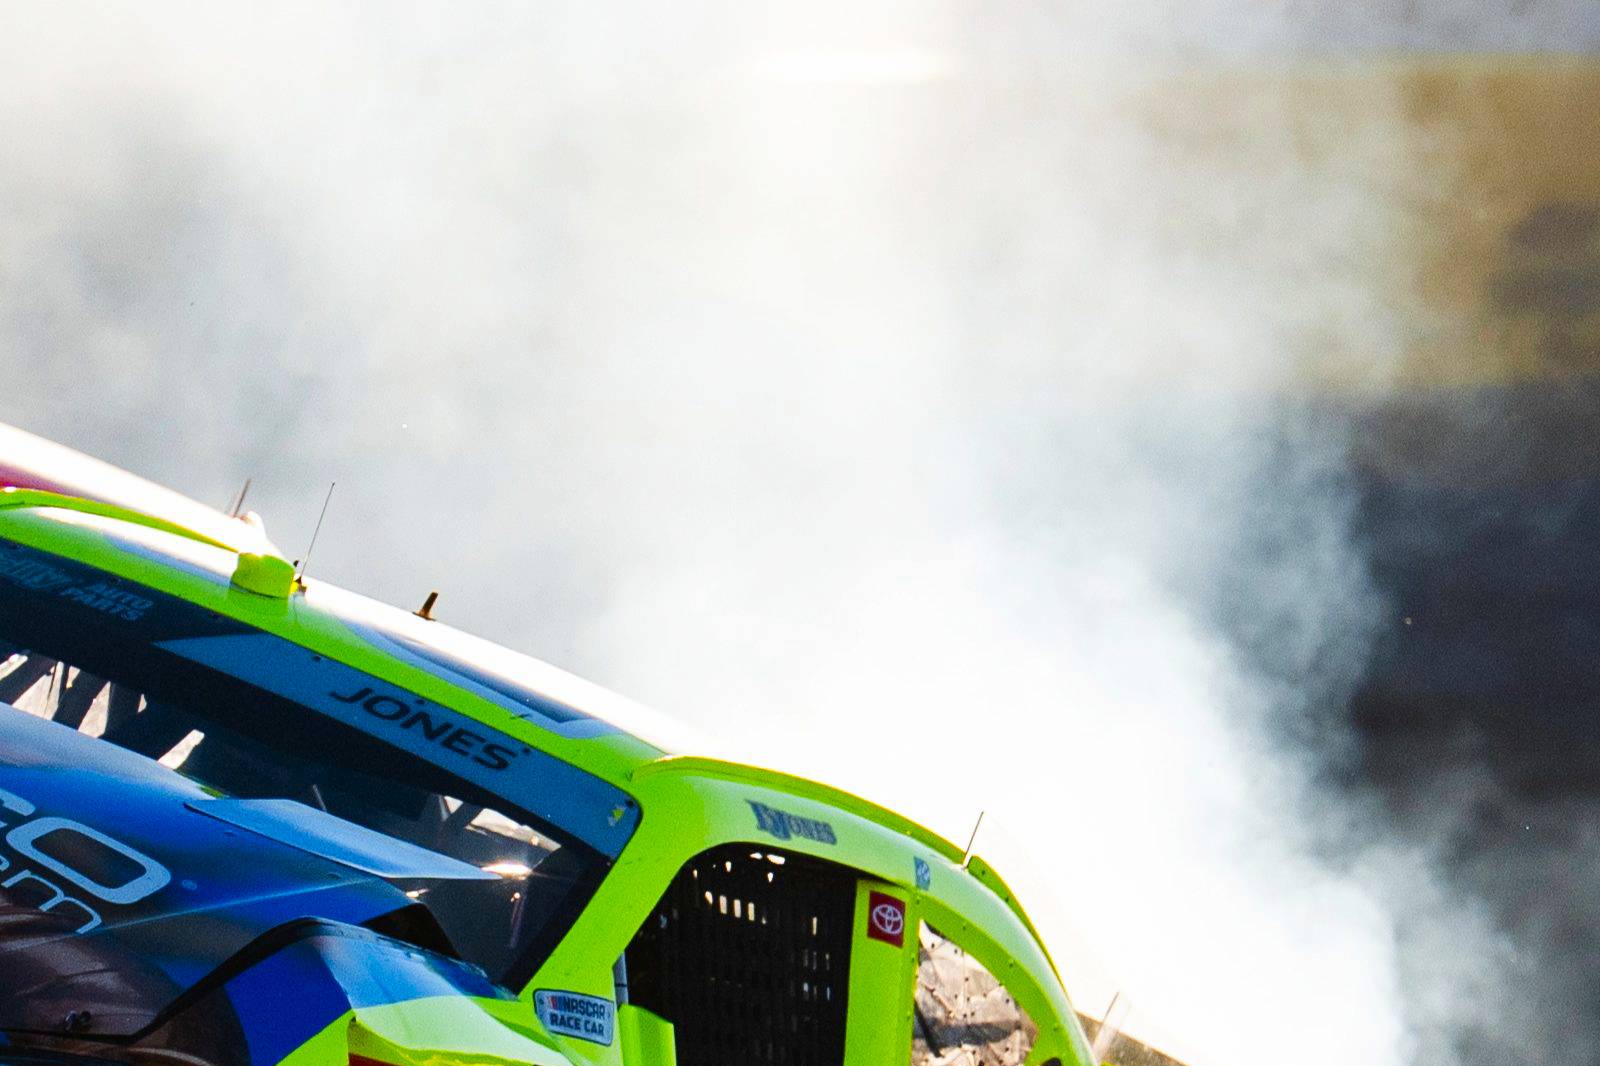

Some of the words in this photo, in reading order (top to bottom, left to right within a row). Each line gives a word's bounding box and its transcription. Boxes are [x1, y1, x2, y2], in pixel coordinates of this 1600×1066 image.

[328, 686, 519, 771] JONES
[563, 995, 606, 1020] NASCAR
[549, 1011, 581, 1031] RACE
[584, 1019, 605, 1036] CAR
